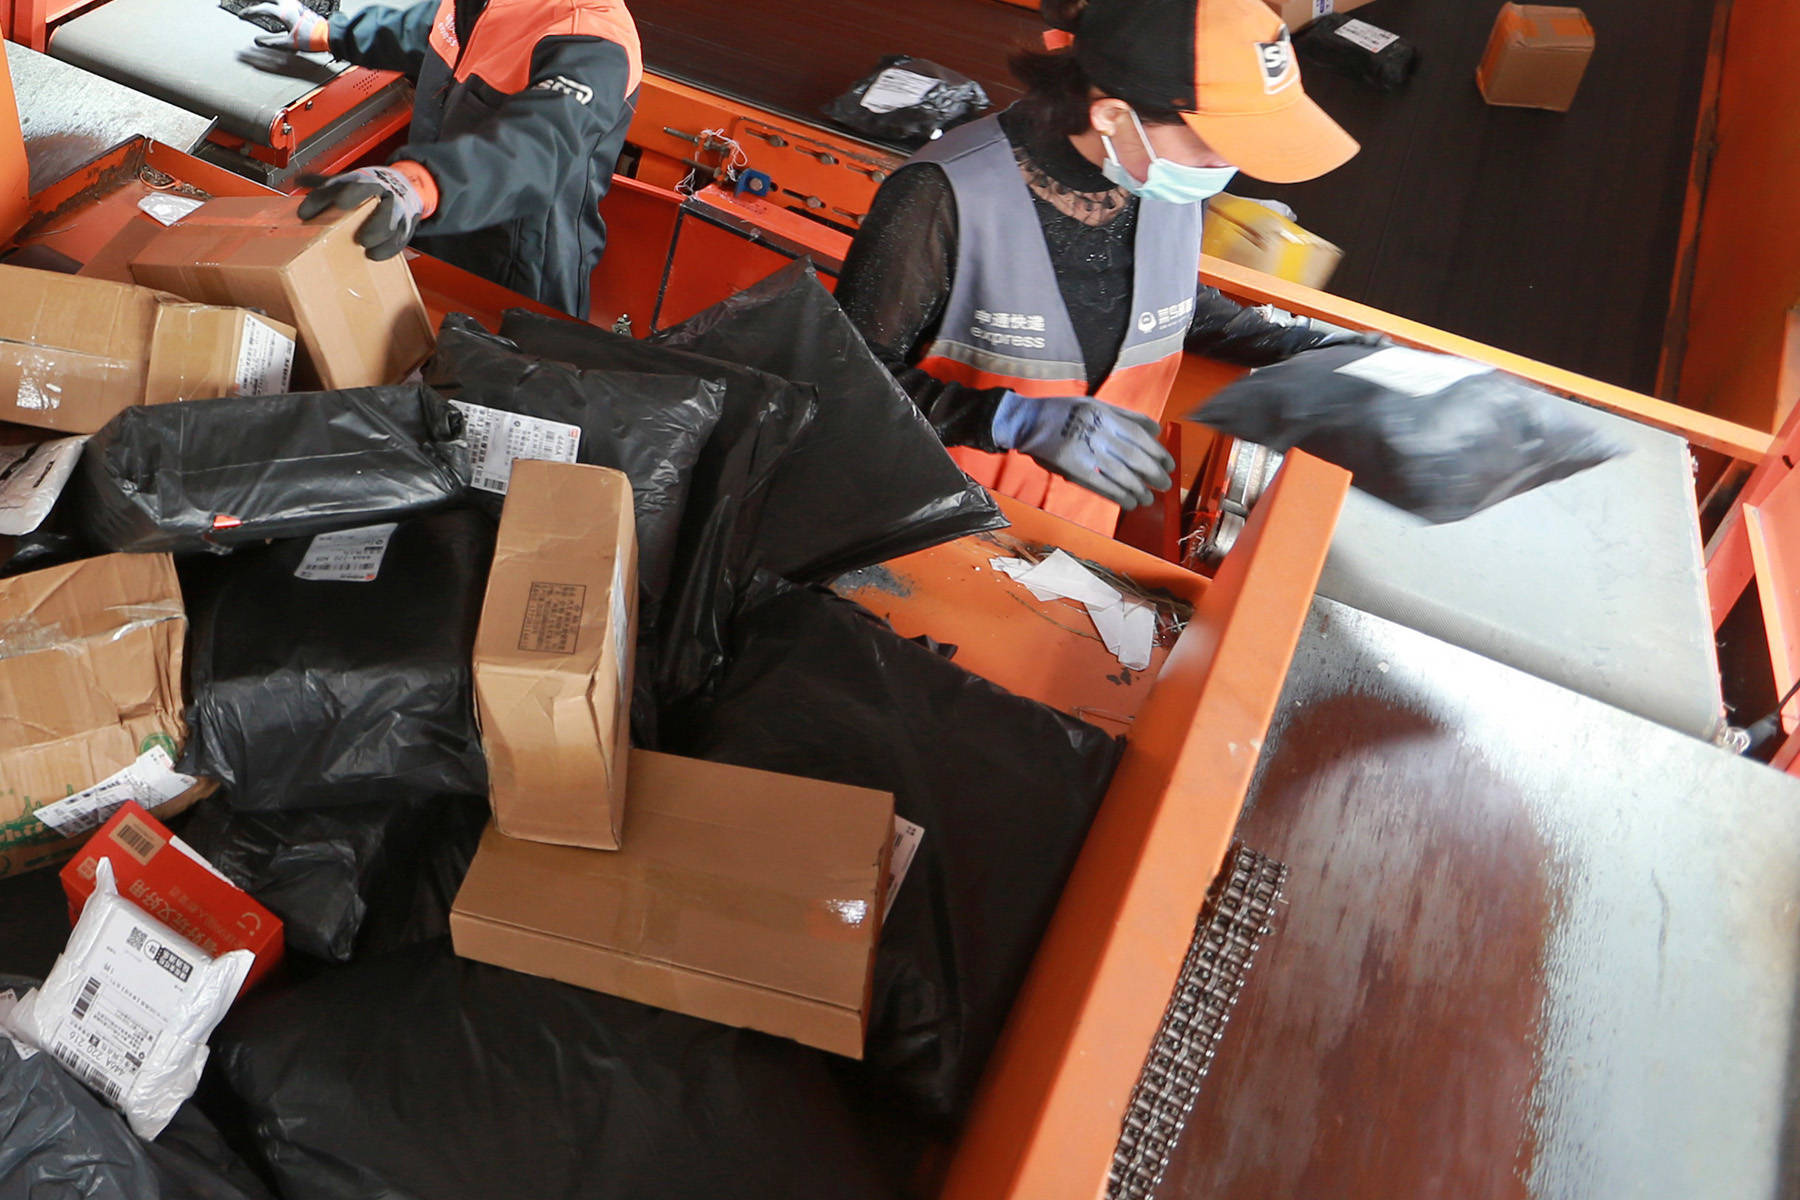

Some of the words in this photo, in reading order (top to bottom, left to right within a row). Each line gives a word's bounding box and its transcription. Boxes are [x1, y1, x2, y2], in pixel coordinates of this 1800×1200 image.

[974, 308, 1046, 332] 申通快递
[970, 325, 1046, 349] express
